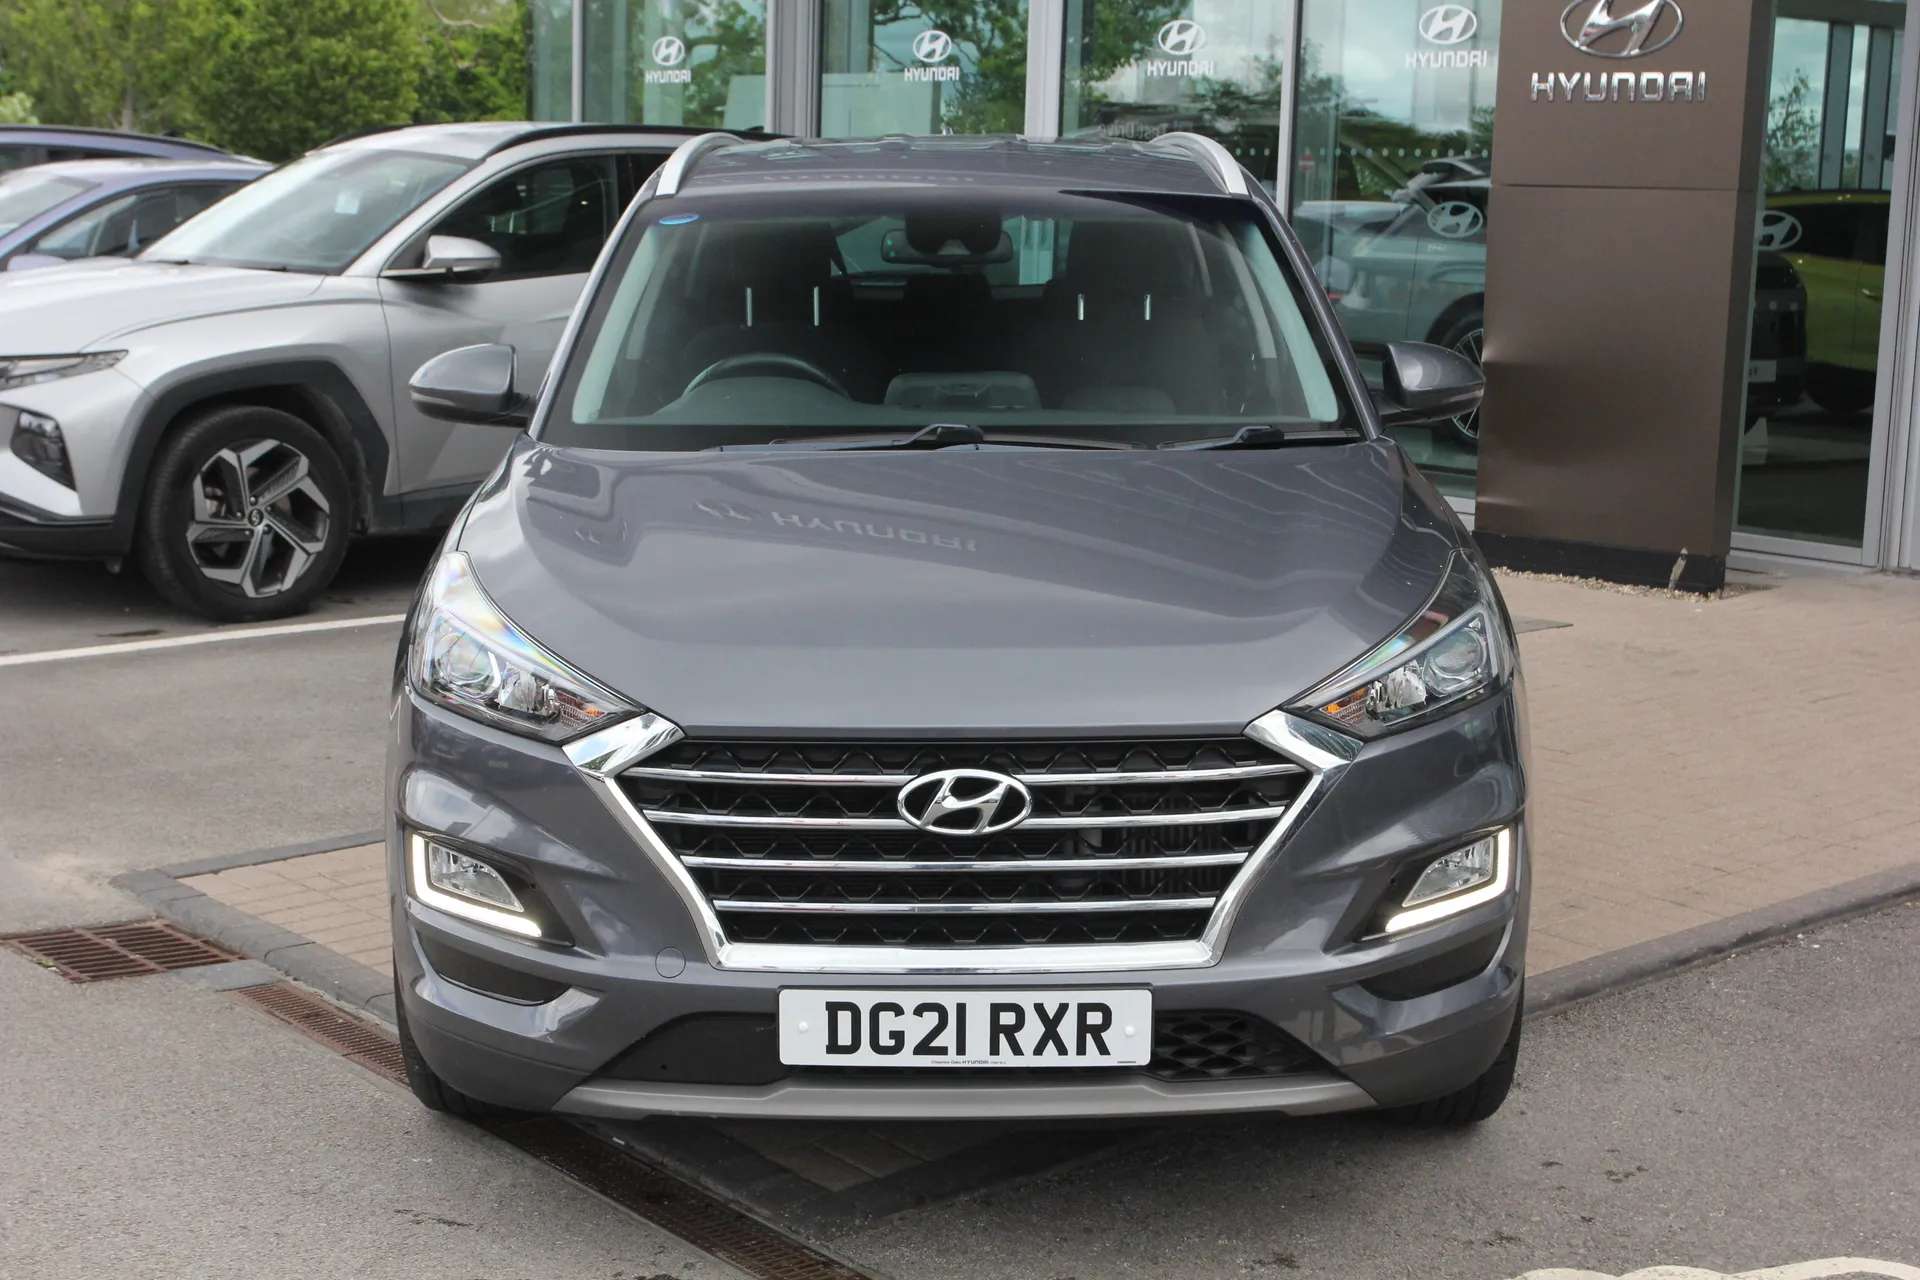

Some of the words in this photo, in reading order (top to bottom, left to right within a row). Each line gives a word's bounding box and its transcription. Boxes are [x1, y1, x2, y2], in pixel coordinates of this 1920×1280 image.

[1147, 60, 1214, 77] HYUNDAI
[1405, 50, 1487, 69] HYUNDAI
[645, 70, 691, 84] HYUNDAI
[904, 66, 960, 82] HYUNDAI
[1530, 71, 1706, 102] HYUNDAI
[825, 1001, 966, 1057] DG21
[989, 1002, 1113, 1057] RXR
